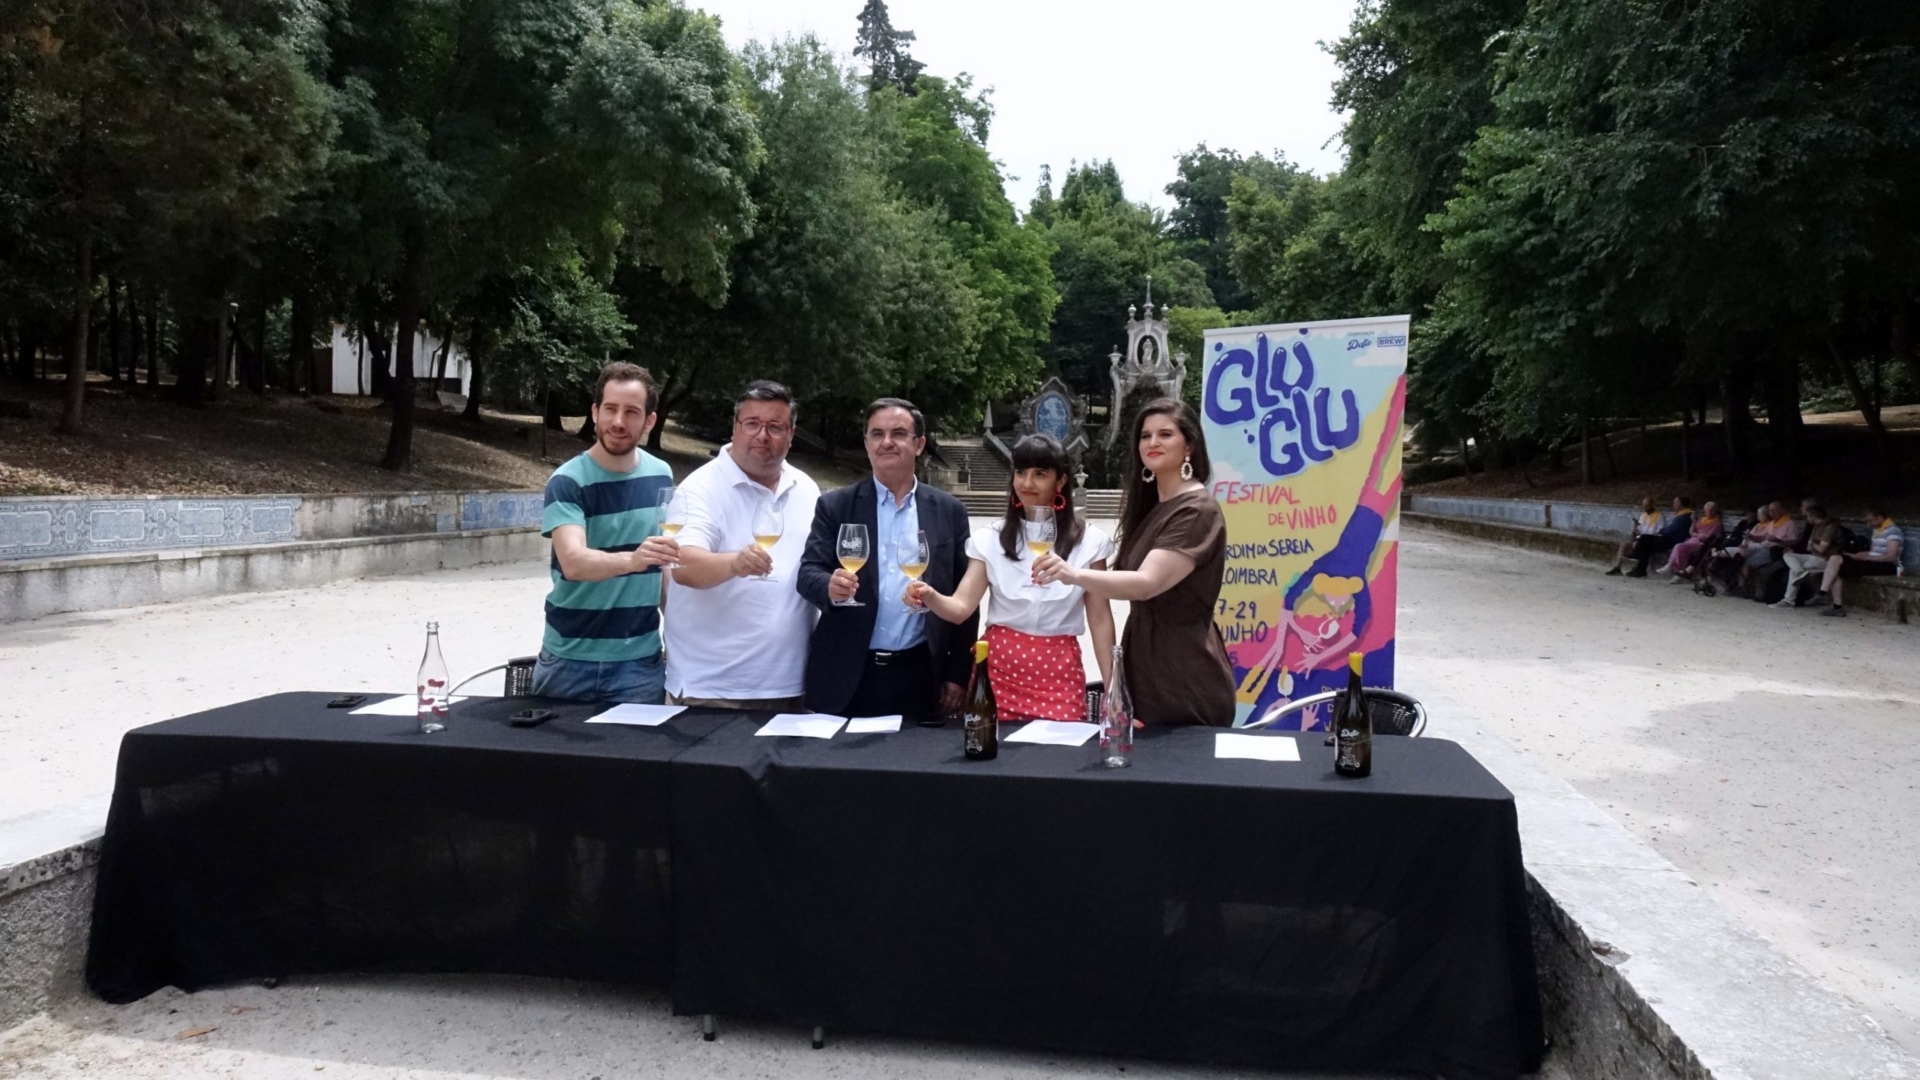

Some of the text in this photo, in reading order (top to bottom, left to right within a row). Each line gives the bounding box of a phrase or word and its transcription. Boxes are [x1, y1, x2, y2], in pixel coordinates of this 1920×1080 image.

[1268, 504, 1337, 530] DE VINHO
[1224, 543, 1256, 560] RDIM
[1268, 538, 1314, 556] SEREIA
[1222, 567, 1278, 586] OIMBRA
[1217, 598, 1257, 619] 7-29
[1221, 620, 1268, 643] UNHO
